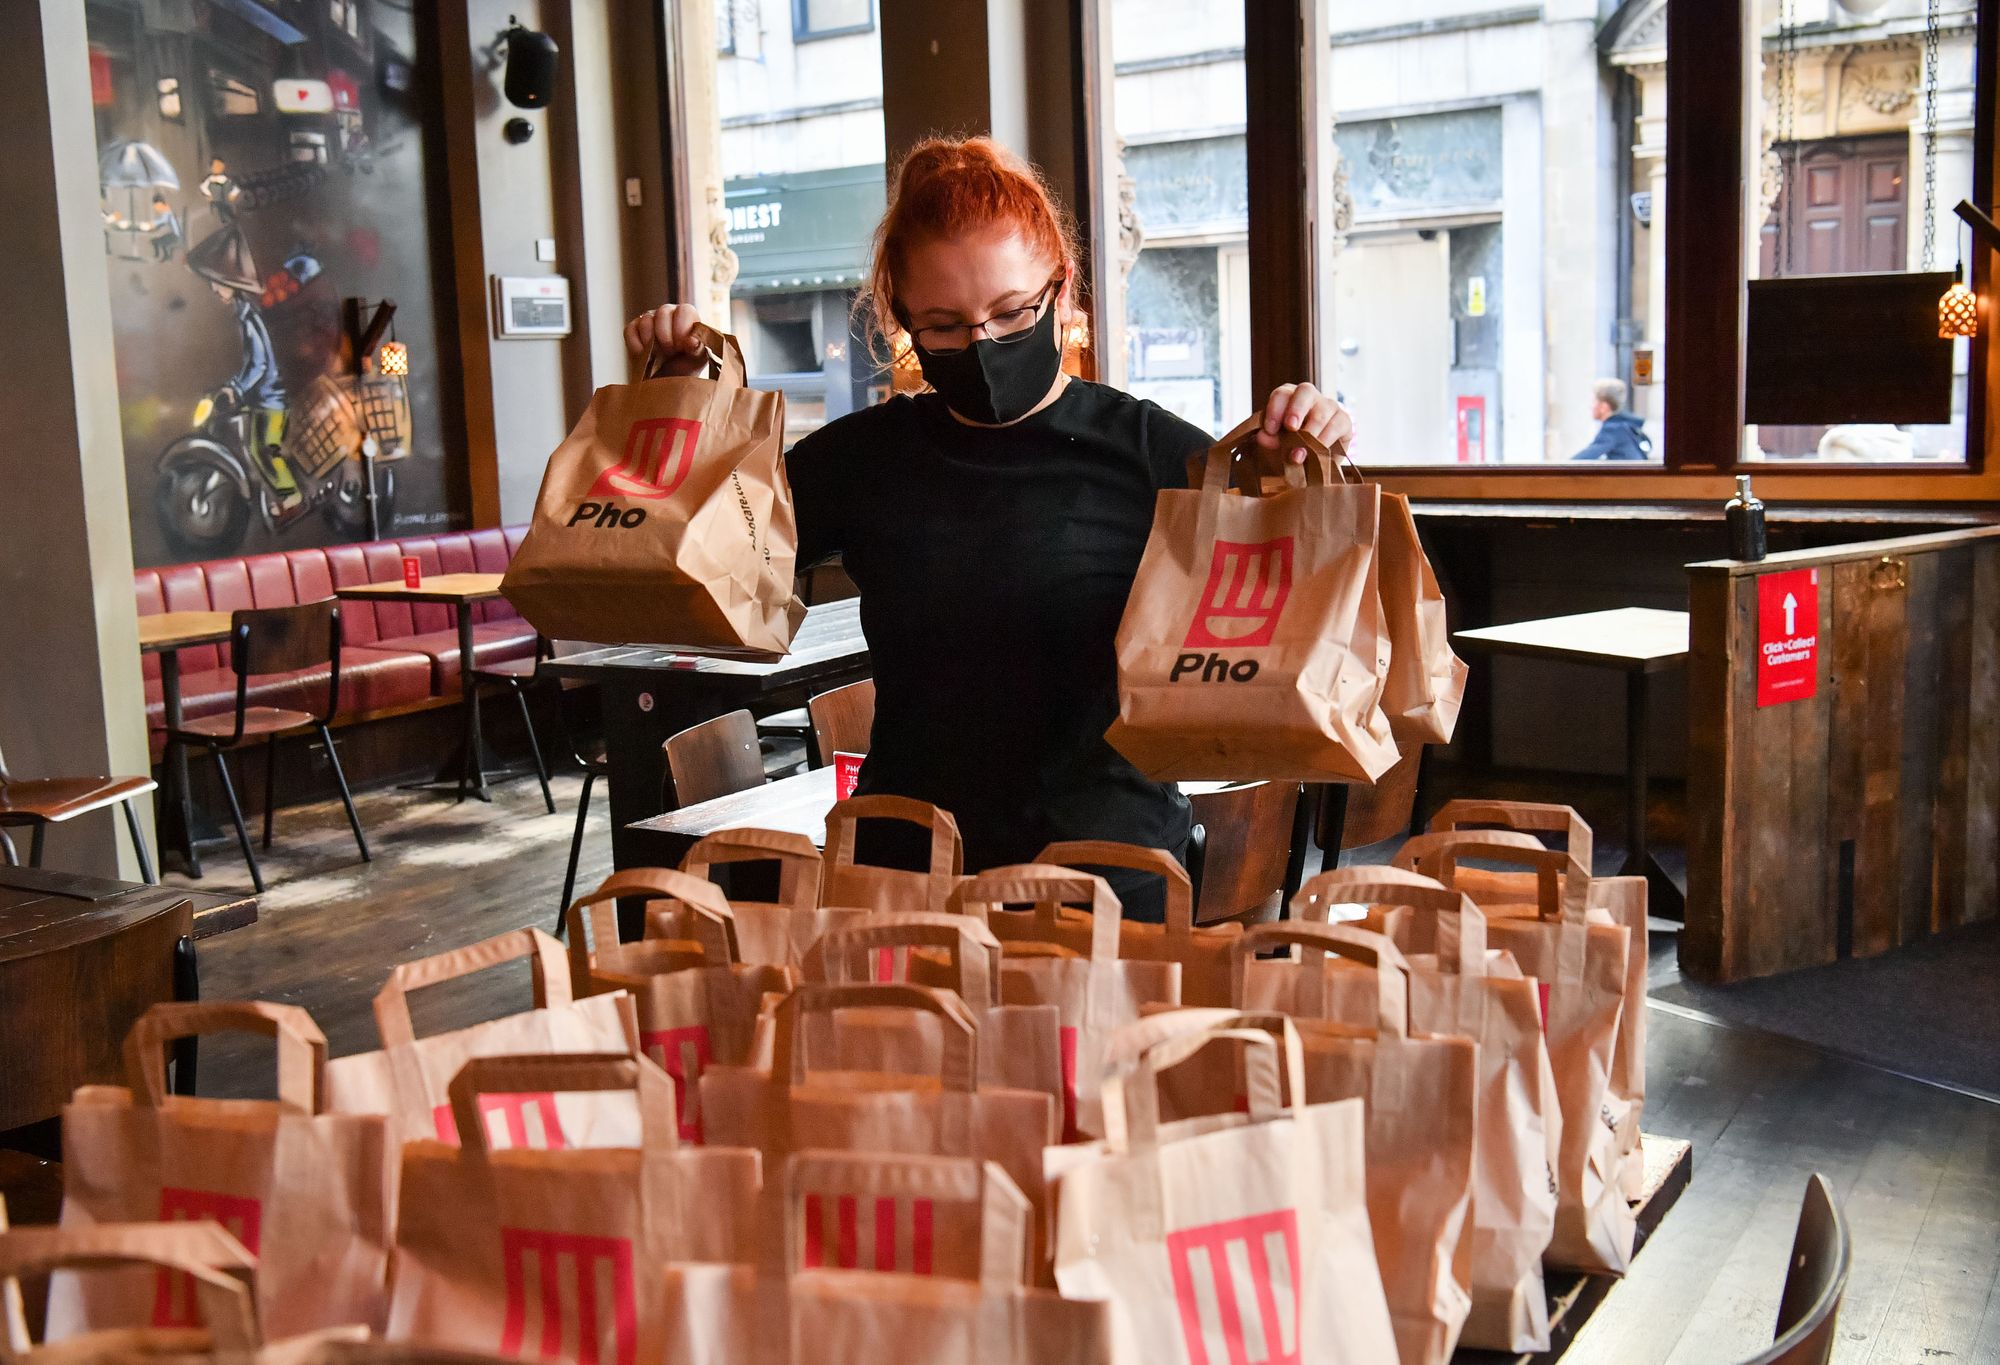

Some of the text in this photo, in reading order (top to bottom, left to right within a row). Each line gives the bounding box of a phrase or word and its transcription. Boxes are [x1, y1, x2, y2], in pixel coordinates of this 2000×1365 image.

[566, 502, 647, 529] Pho
[1169, 653, 1260, 683] Pho
[1766, 649, 1811, 666] Customers
